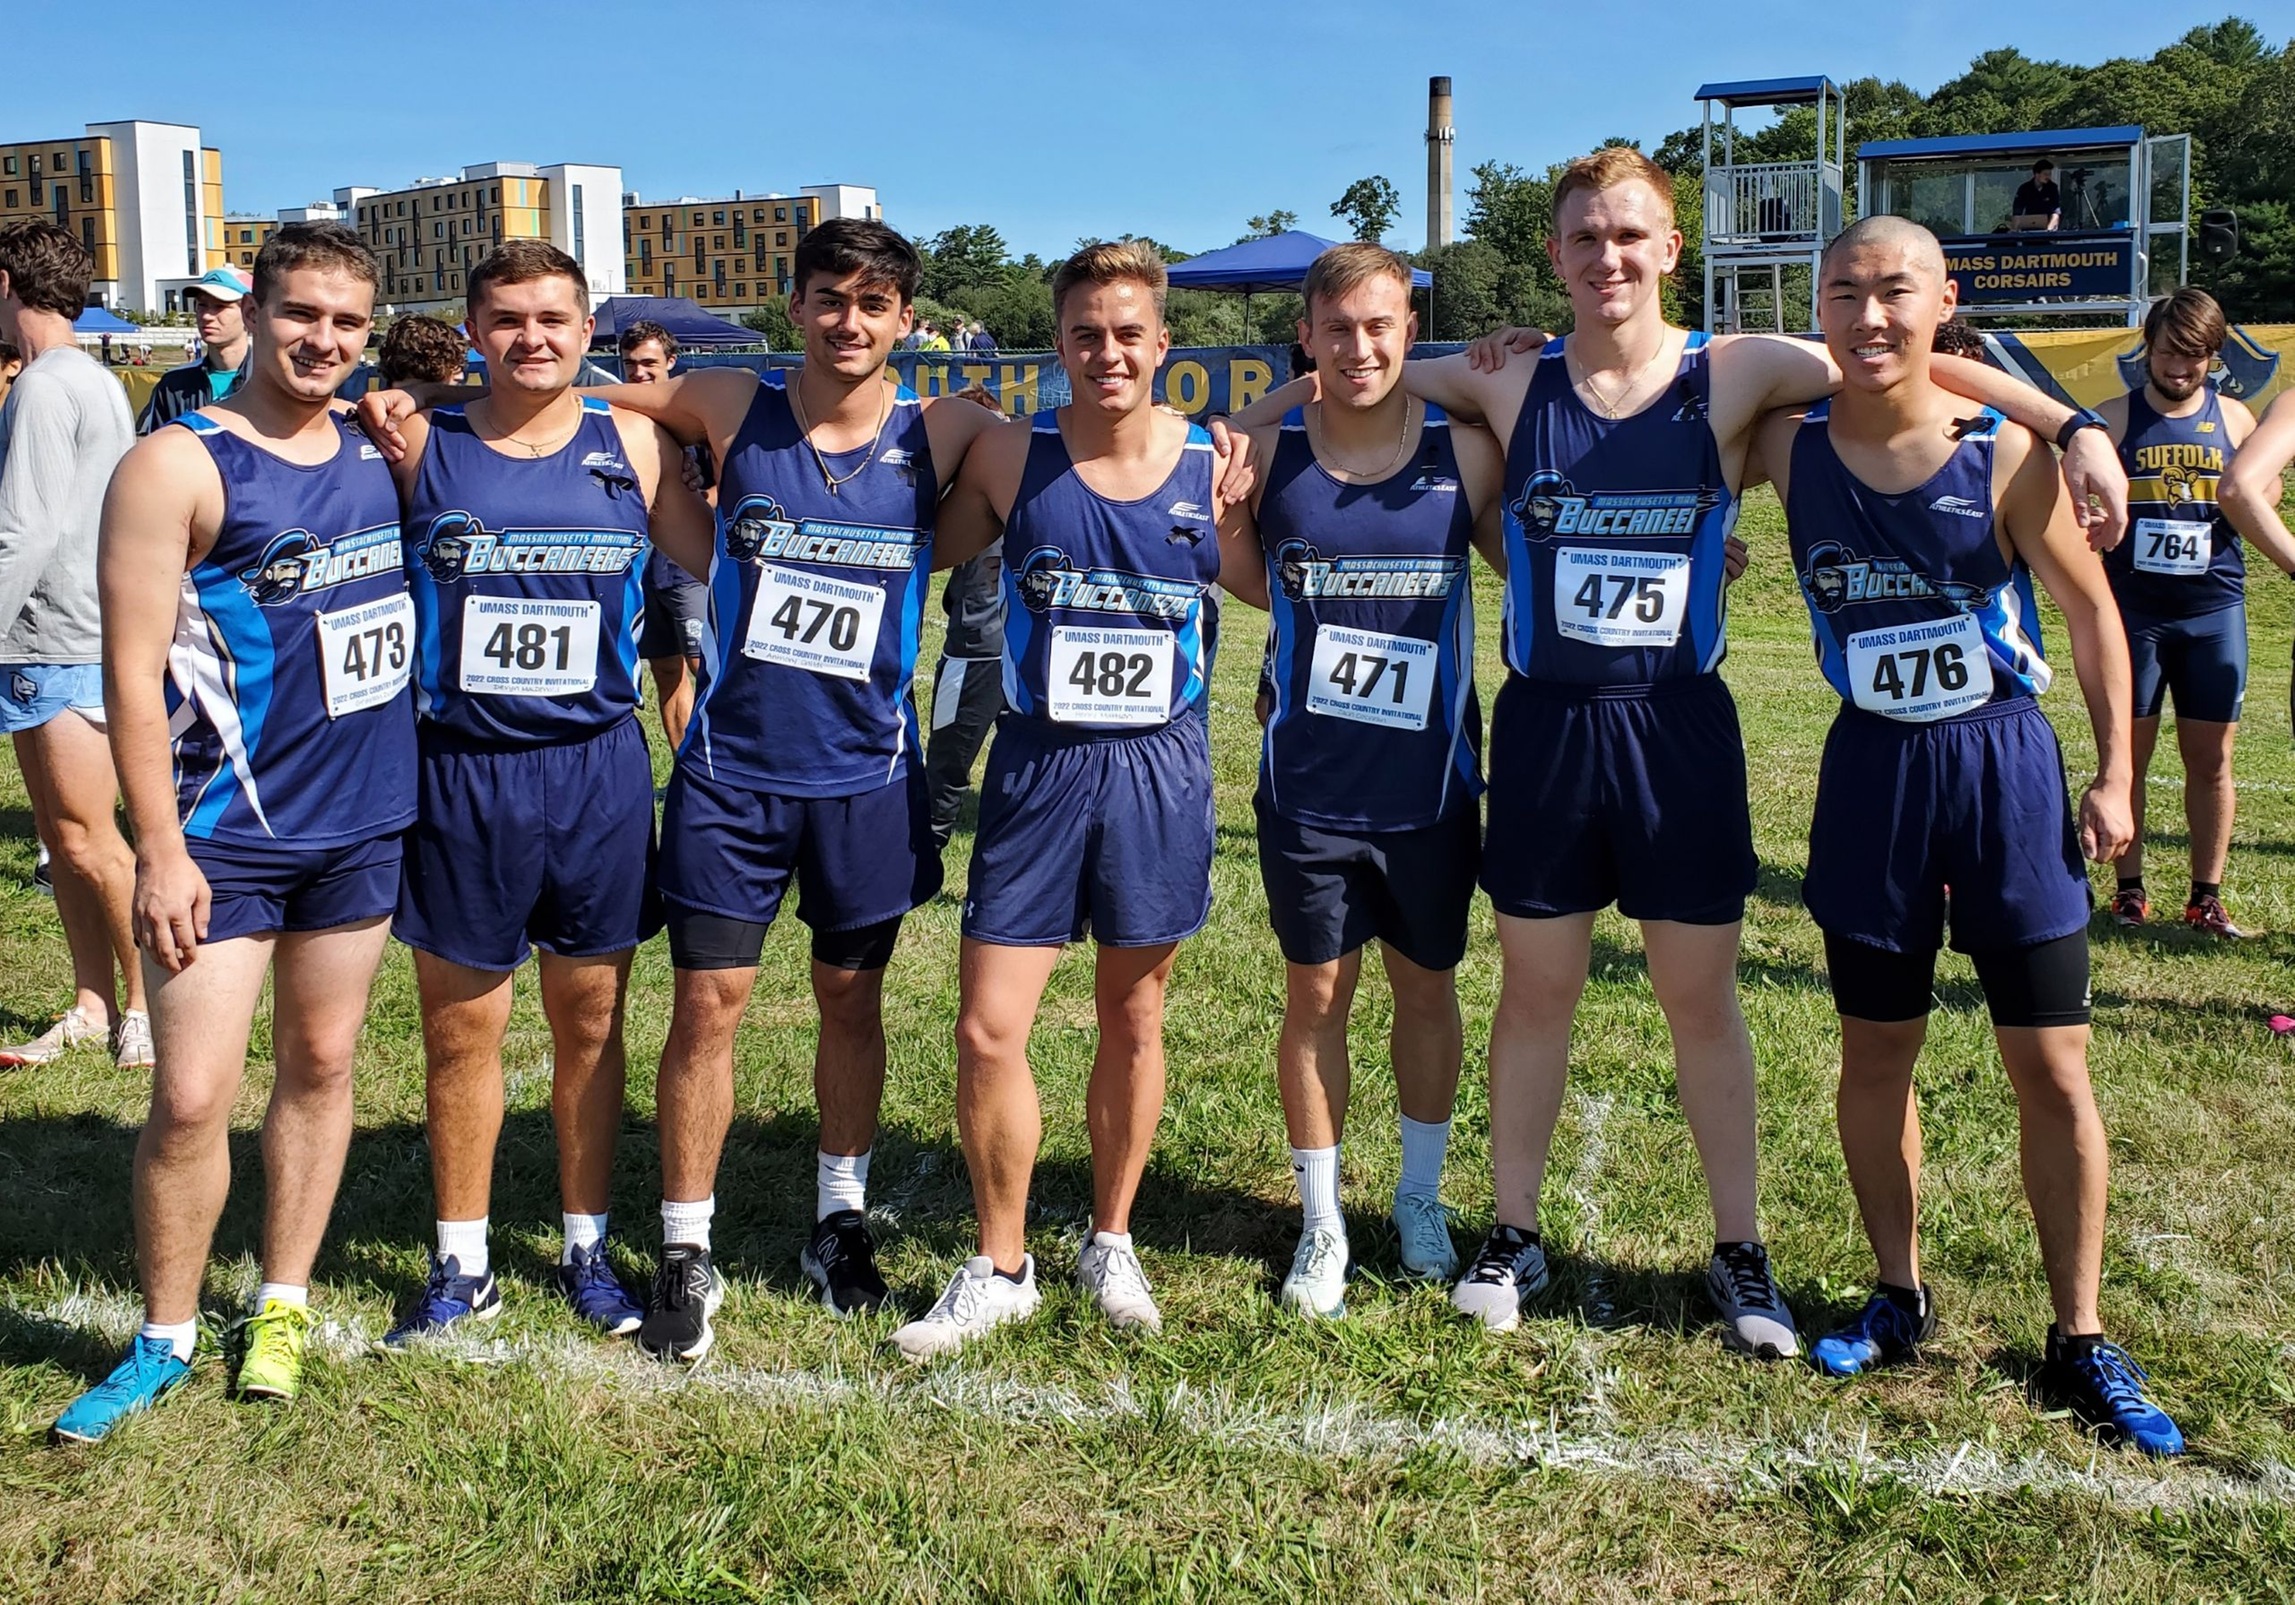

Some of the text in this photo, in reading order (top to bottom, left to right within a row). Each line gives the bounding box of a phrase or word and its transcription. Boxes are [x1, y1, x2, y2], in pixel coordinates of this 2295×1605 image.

[2001, 252, 2118, 270] DARTMOUTH
[1974, 272, 2072, 289] CORSAIRS
[2135, 444, 2224, 473] SUFFOLK
[508, 533, 633, 545] MASSACHUSETTS MARITIME
[756, 519, 921, 568] BUCCANEERS
[805, 524, 880, 539] MASSACHUSETTS
[453, 535, 640, 573] BUCCANEERS
[2146, 532, 2199, 561] 764
[1340, 560, 1414, 570] MASSACHUSETTS
[1570, 553, 1676, 570] UMASS DARTMOUTH
[774, 571, 874, 603] UMASS DARTMOUTH
[1298, 562, 1460, 597] BUCCANEERS
[479, 602, 588, 618] UMASS DARTMOUTH
[1573, 573, 1666, 623] 475
[331, 600, 407, 631] UMASS DARTMOUTH
[770, 594, 861, 652] 470
[1064, 631, 1163, 646] UMASS DARTMOUTH
[1329, 631, 1427, 656] UMASS DARTMOUTH
[1600, 627, 1631, 636] COUNTRY
[1858, 620, 1967, 649] UMASS DARTMOUTH
[343, 621, 406, 682] 473
[483, 622, 571, 671] 481
[750, 640, 768, 650] 2022
[769, 644, 791, 655] CROSS
[792, 648, 822, 660] COUNTRY
[823, 655, 865, 669] INVITATIONAL
[466, 674, 485, 682] 2022
[486, 676, 510, 684] CROSS
[511, 676, 543, 685] COUNTRY
[1068, 651, 1154, 698] 482
[1328, 652, 1409, 704] 471
[1872, 642, 1969, 700] 476
[349, 689, 368, 699] CROSS
[369, 682, 392, 693] COUNTRY
[1071, 703, 1092, 711] CROSS
[1094, 703, 1123, 712] COUNTRY
[1124, 705, 1164, 713] INVITATIONAL
[1312, 695, 1329, 706] 2022
[1329, 699, 1350, 709] CROSS
[1351, 703, 1380, 715] COUNTRY
[1381, 708, 1422, 721] INVITATIONAL
[1884, 707, 1908, 715] CROSS
[1909, 701, 1941, 713] COUNTRY
